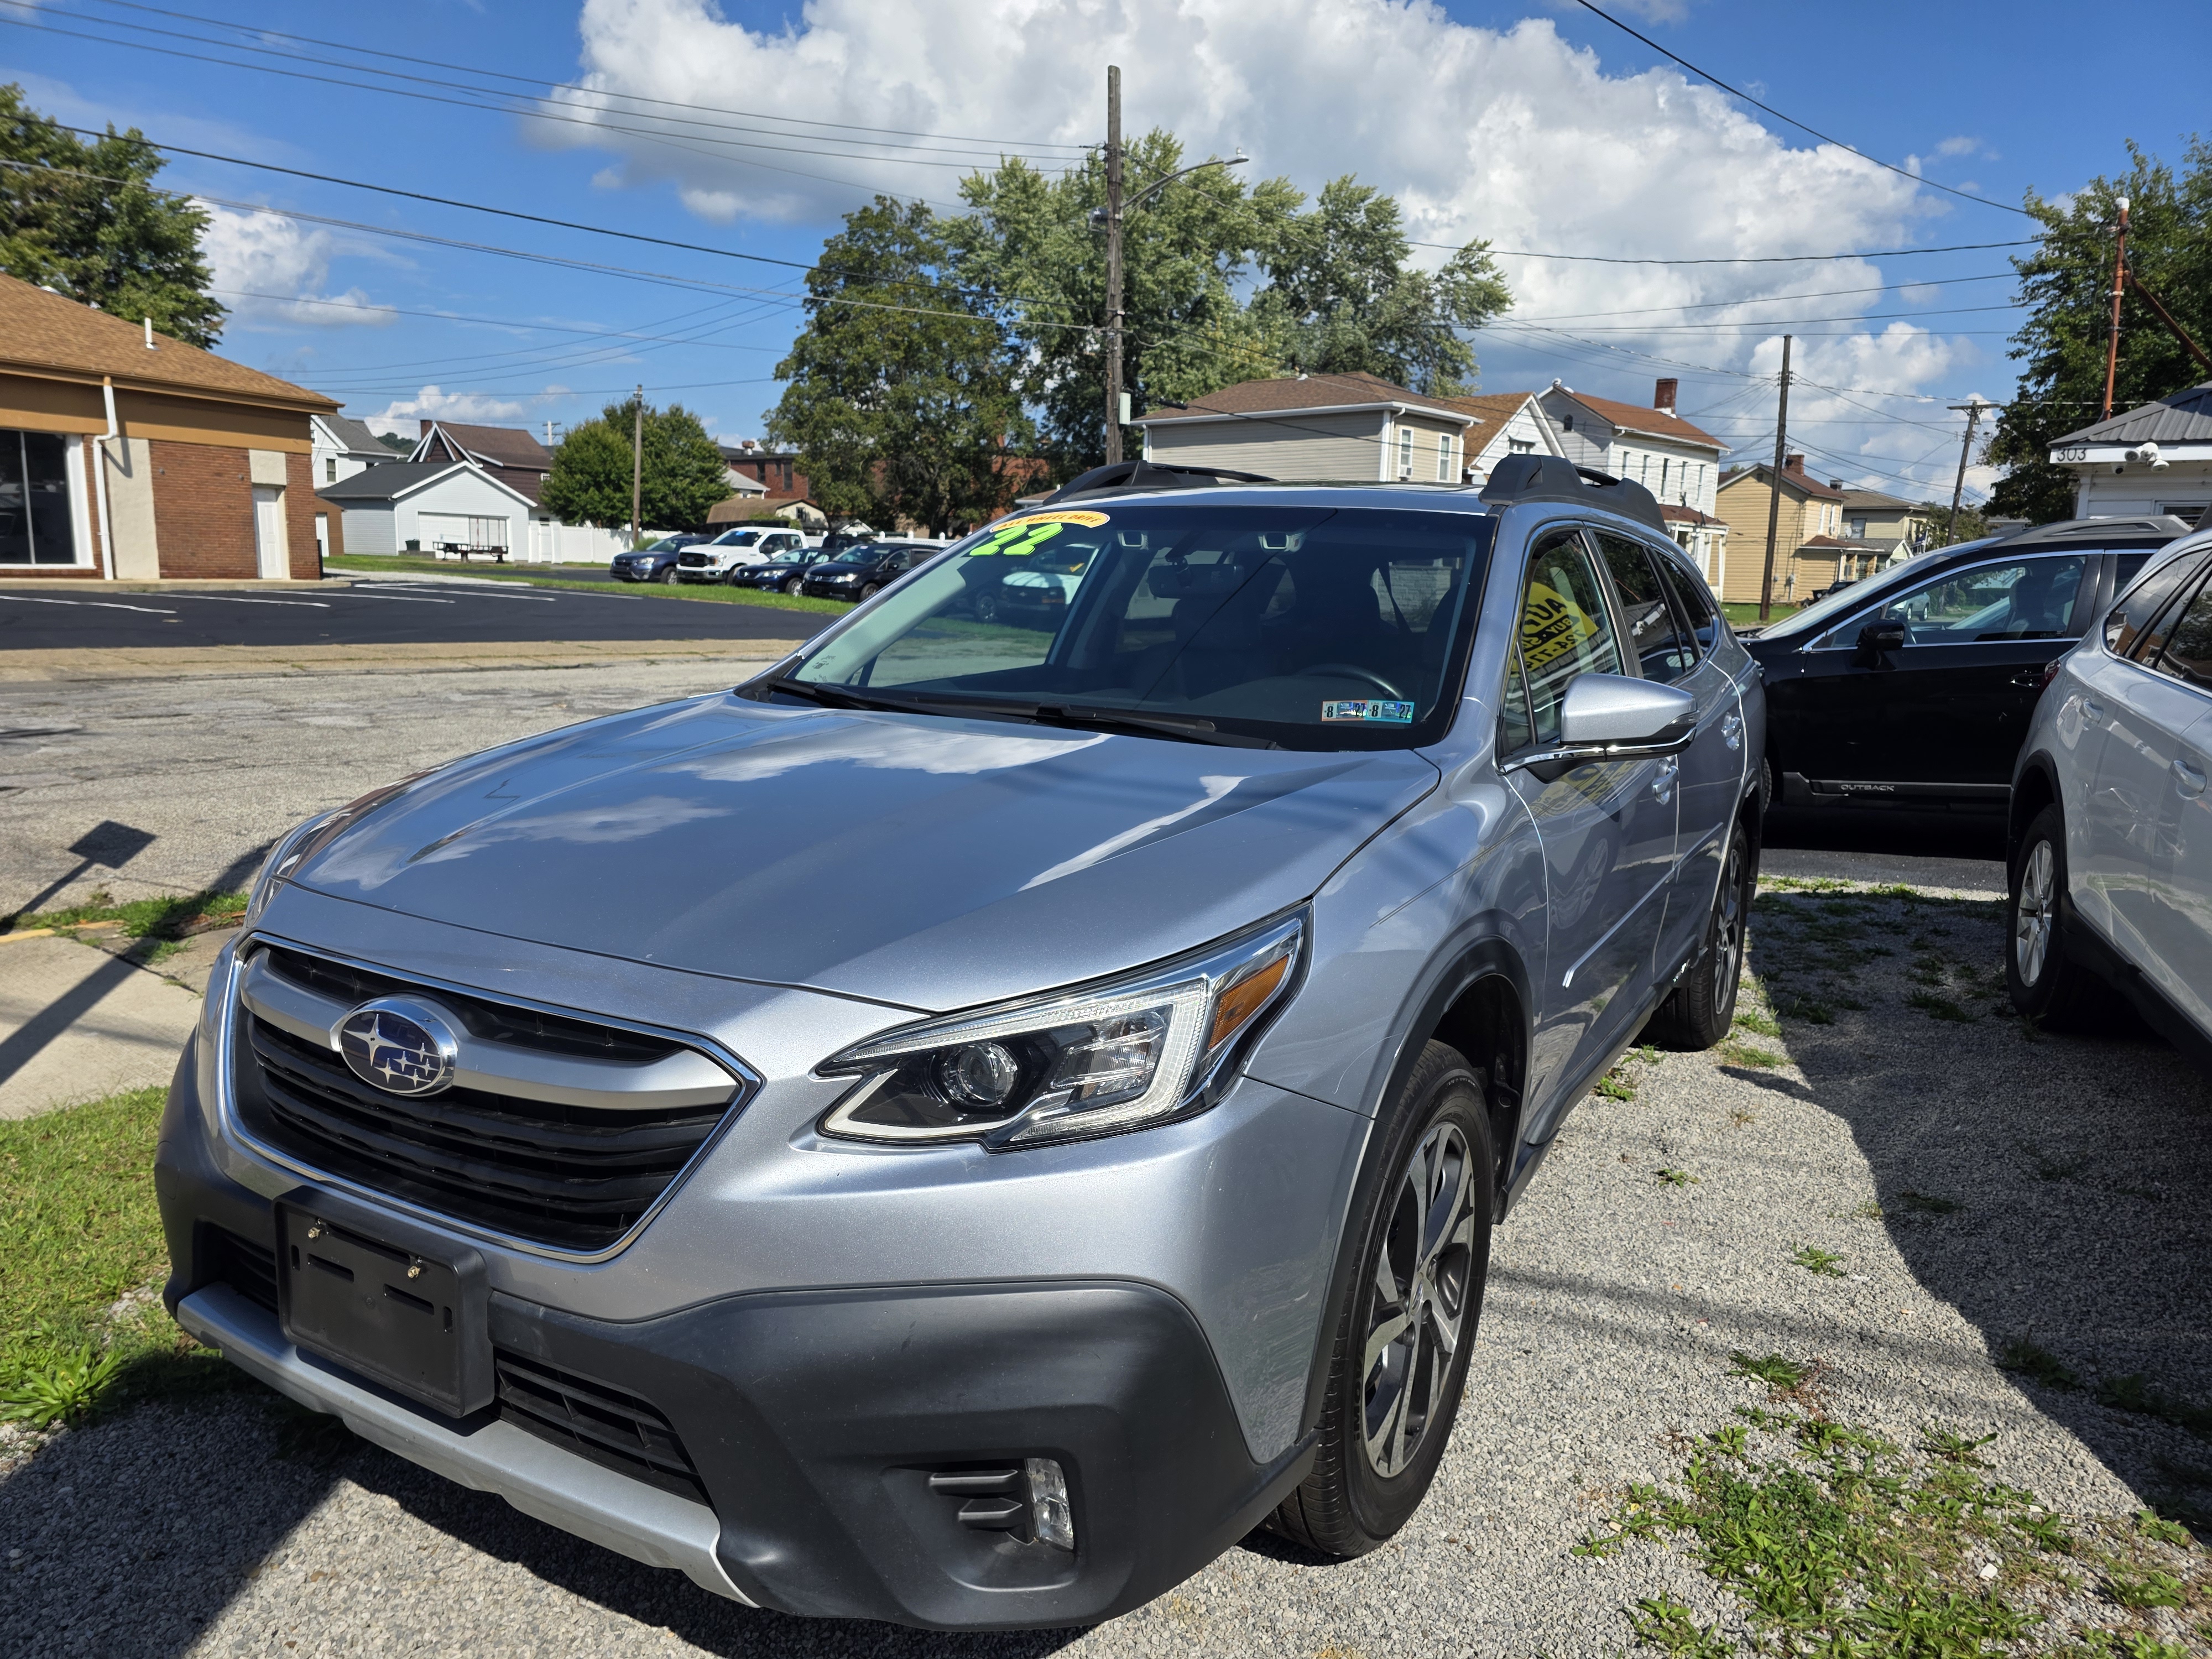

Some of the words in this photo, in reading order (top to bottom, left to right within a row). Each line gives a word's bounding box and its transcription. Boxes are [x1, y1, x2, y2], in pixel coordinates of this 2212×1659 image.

[2057, 448, 2086, 461] 303
[969, 523, 1063, 556] 22
[1327, 706, 1334, 717] 8
[1355, 703, 1365, 718] 27
[1371, 705, 1379, 717] 8
[1399, 705, 1411, 719] 27
